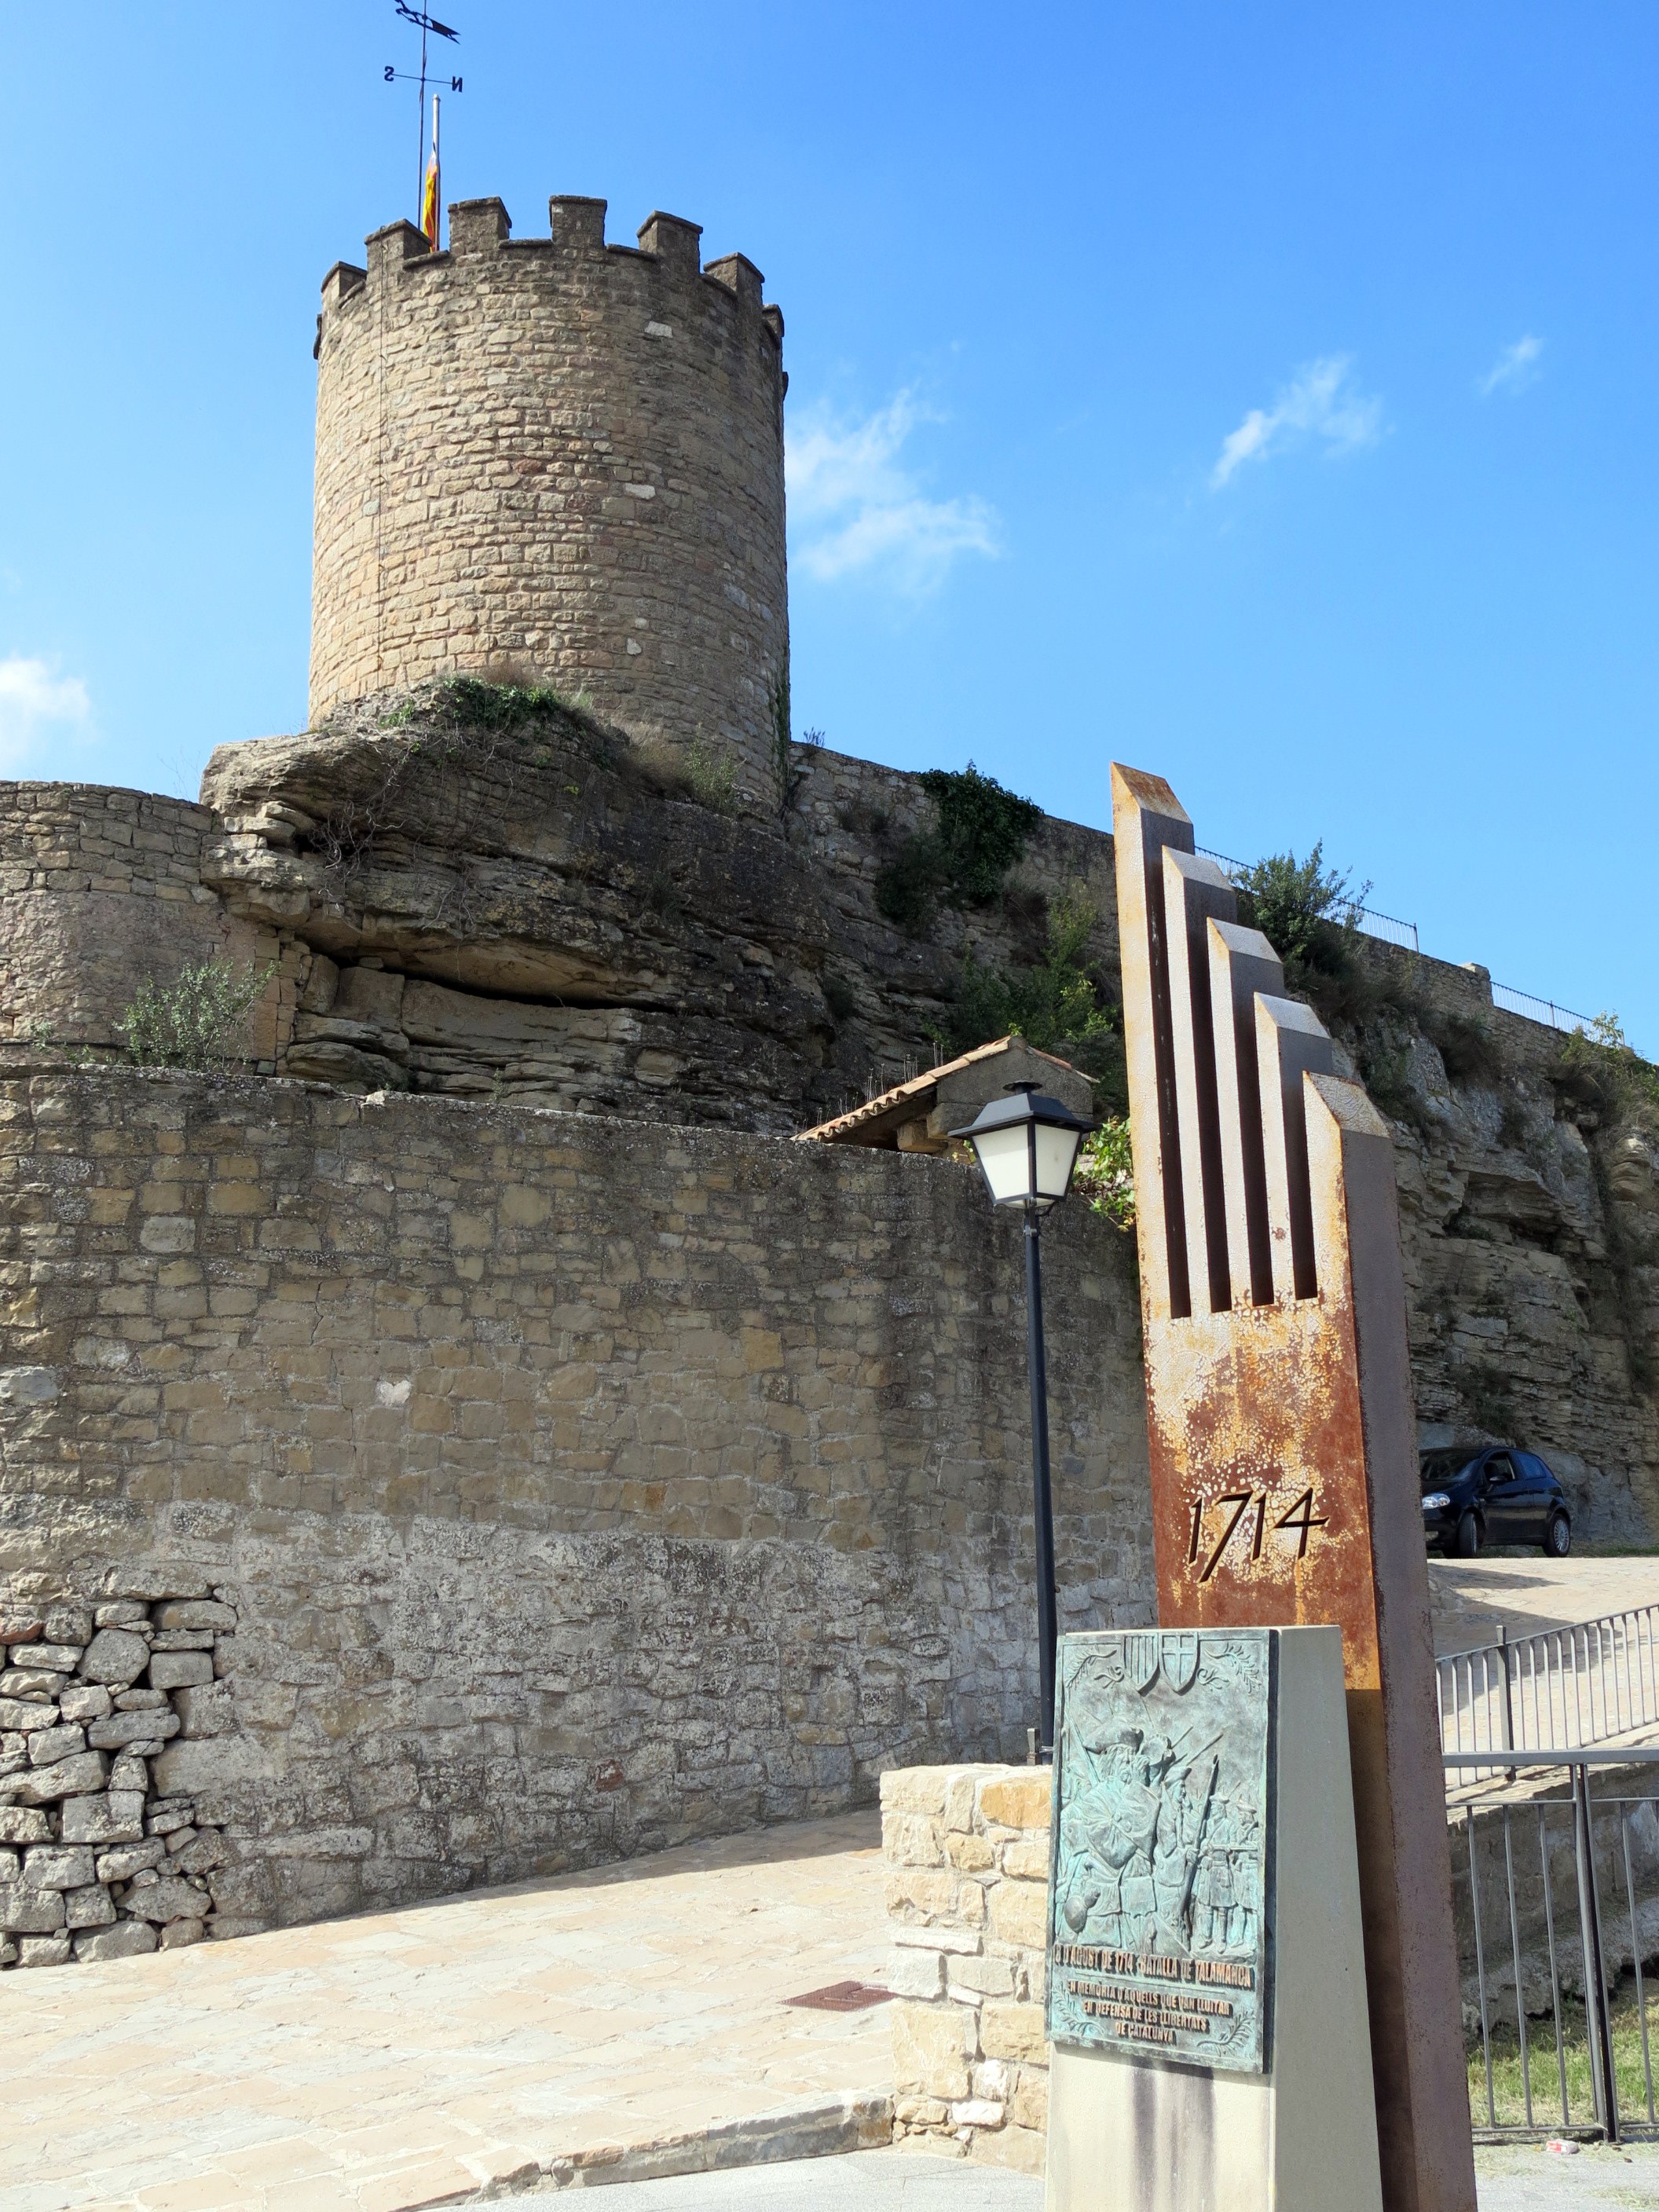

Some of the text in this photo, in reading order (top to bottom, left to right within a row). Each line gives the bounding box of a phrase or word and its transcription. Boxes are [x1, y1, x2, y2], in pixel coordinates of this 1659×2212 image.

[1188, 1487, 1330, 1584] 1714
[1063, 1944, 1099, 1968] D'AGOST
[1101, 1949, 1113, 1970] DE
[1115, 1951, 1134, 1973] 1714
[1140, 1954, 1177, 1978] BATALLA
[1181, 1958, 1192, 1979] DE
[1195, 1960, 1251, 1987] TALAMANCA
[1068, 1979, 1076, 1993] EN
[1117, 1987, 1159, 2005] D'AQUELLS
[1161, 1994, 1177, 2009] QUE
[1178, 1996, 1195, 2011] VAN
[1196, 1998, 1230, 2016] LLUITAR
[1084, 1999, 1207, 2031] EN DEFENSA DE LES LLIBERTATS
[1115, 2021, 1174, 2043] DE CATALUNYA
